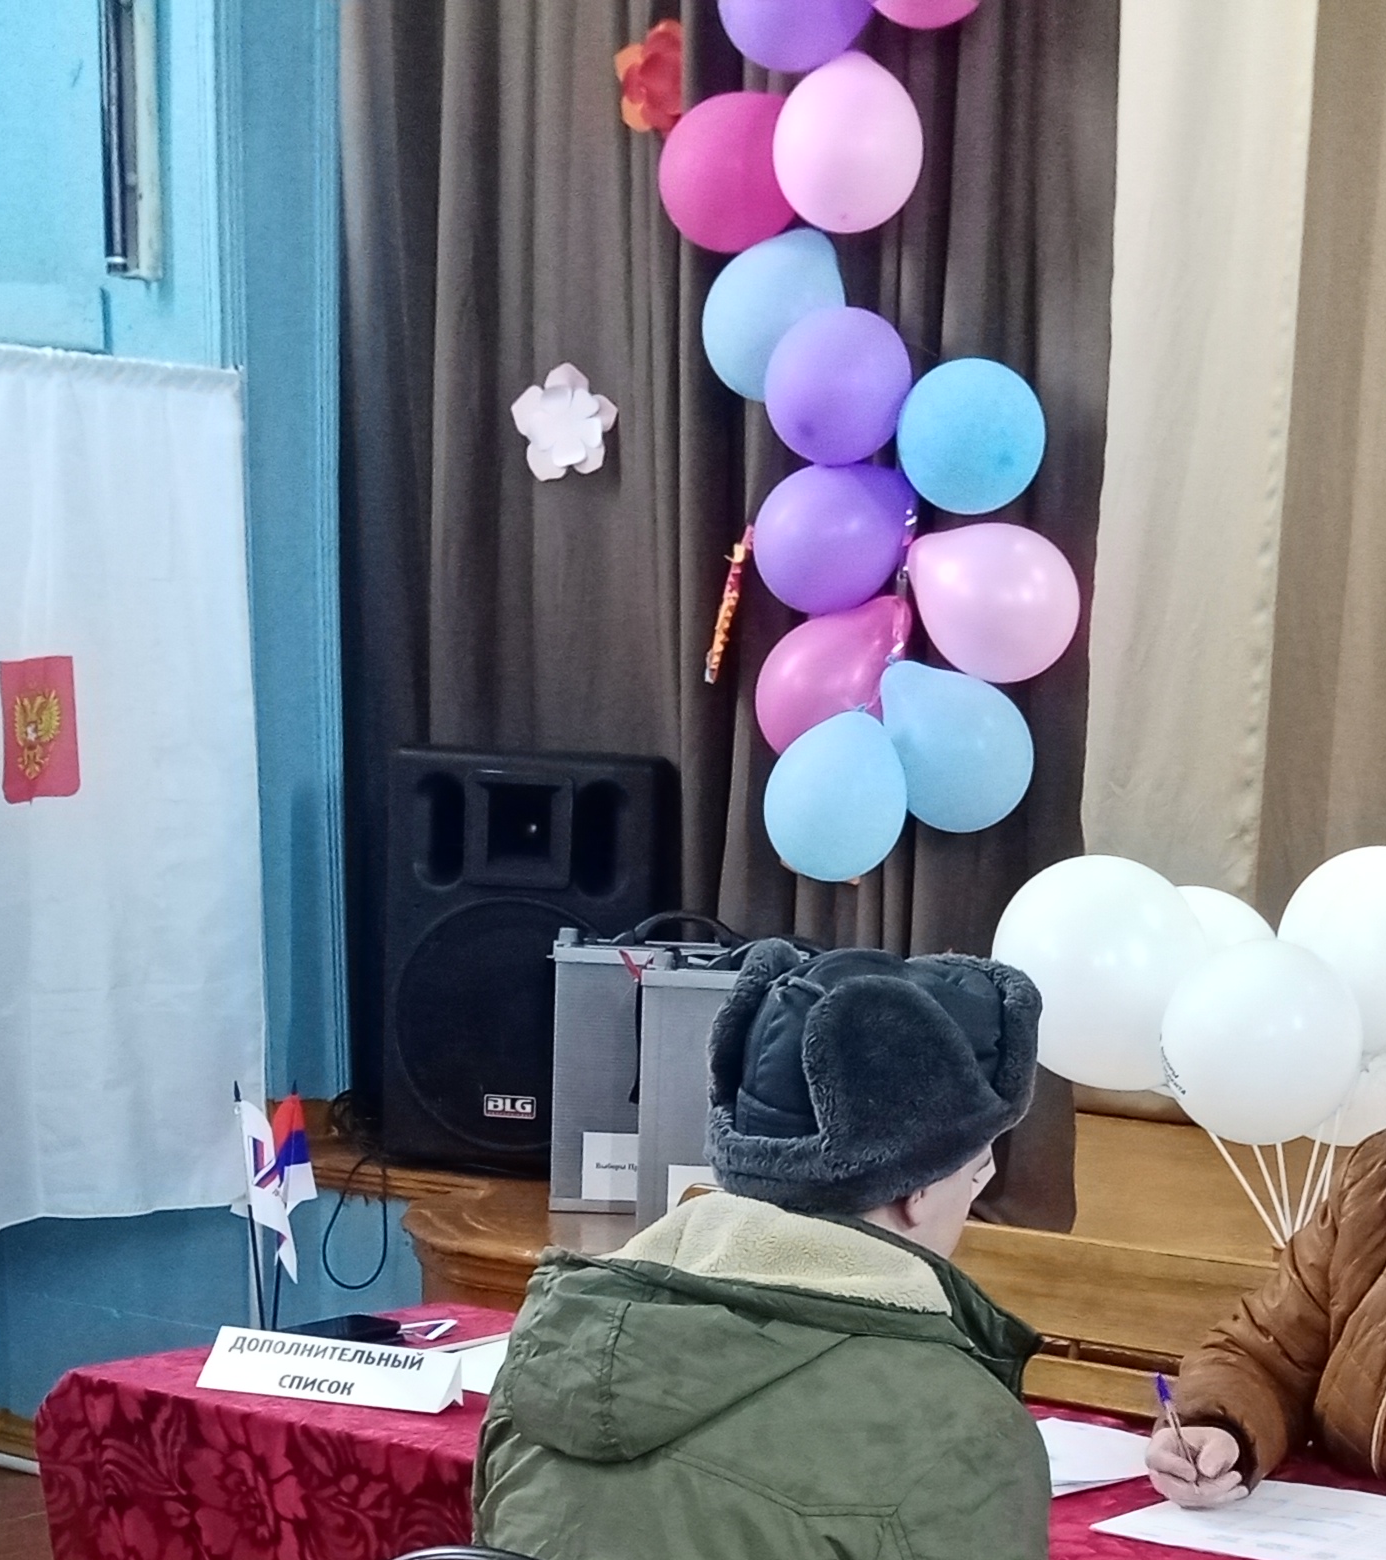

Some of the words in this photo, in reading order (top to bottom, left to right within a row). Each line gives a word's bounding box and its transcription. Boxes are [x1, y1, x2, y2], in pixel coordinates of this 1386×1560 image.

[487, 1097, 532, 1113] BLG
[228, 1335, 424, 1371] ДОПОЛНИТЕЛЬНЫЙ
[278, 1374, 355, 1396] СПИСОК
